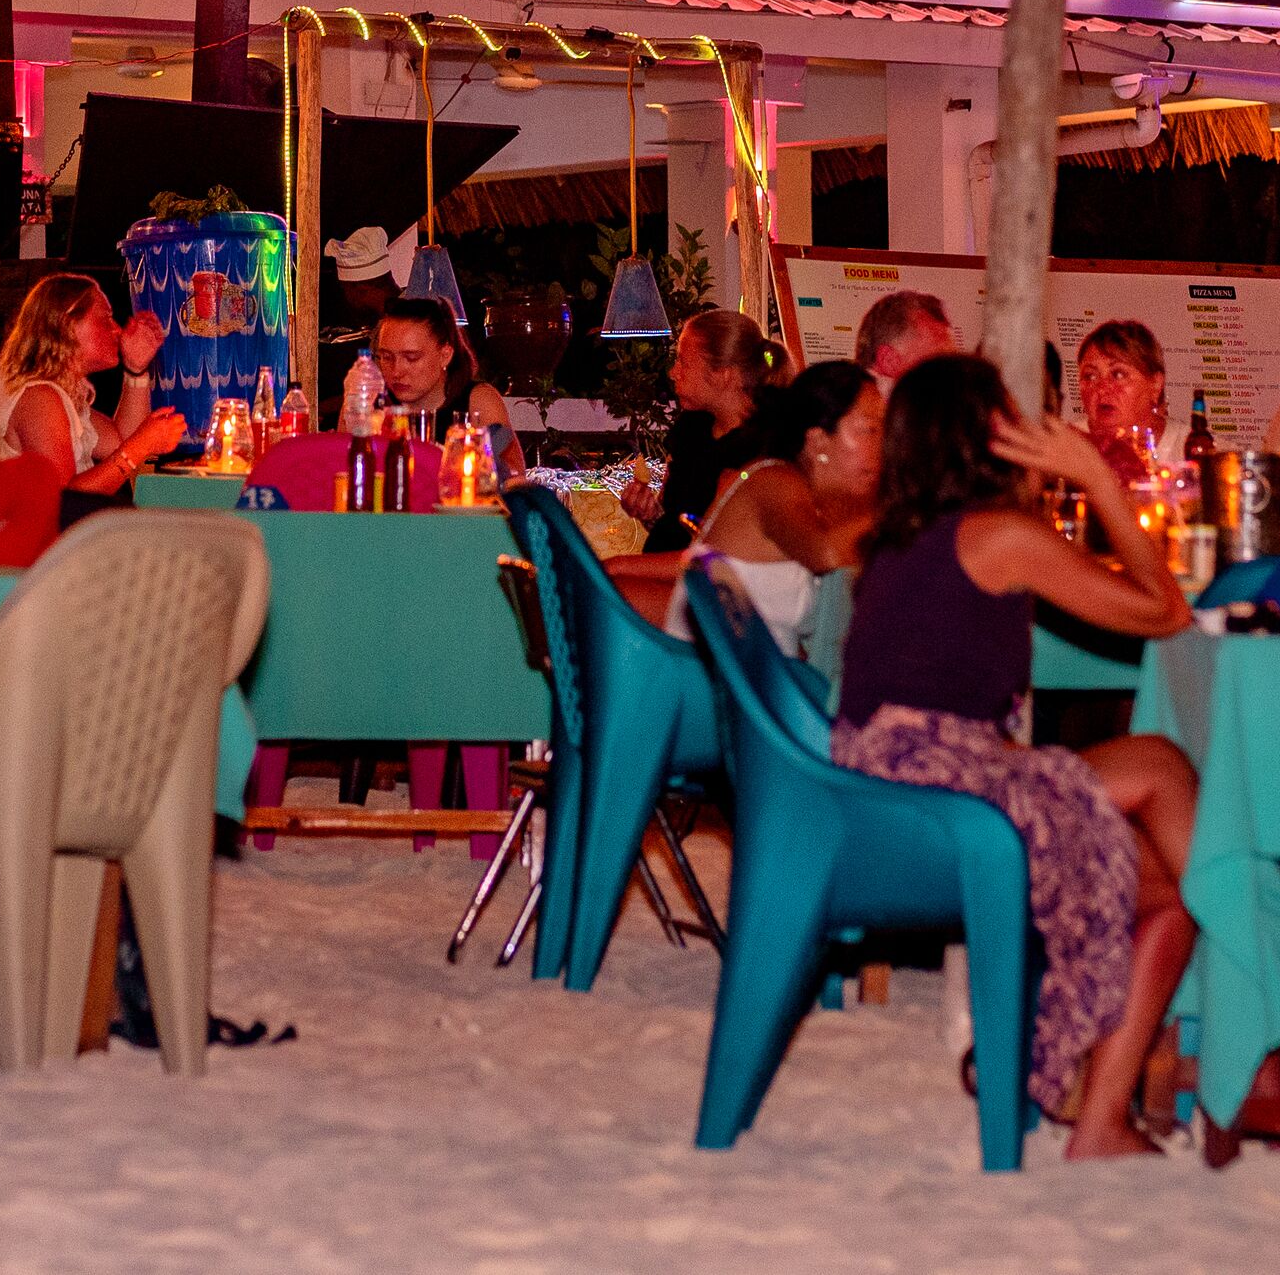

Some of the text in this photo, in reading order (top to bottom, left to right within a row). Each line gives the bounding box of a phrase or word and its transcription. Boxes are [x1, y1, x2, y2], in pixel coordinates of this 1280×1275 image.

[843, 268, 900, 279] FOOD MENU
[1193, 288, 1233, 298] PIZZA MENU
